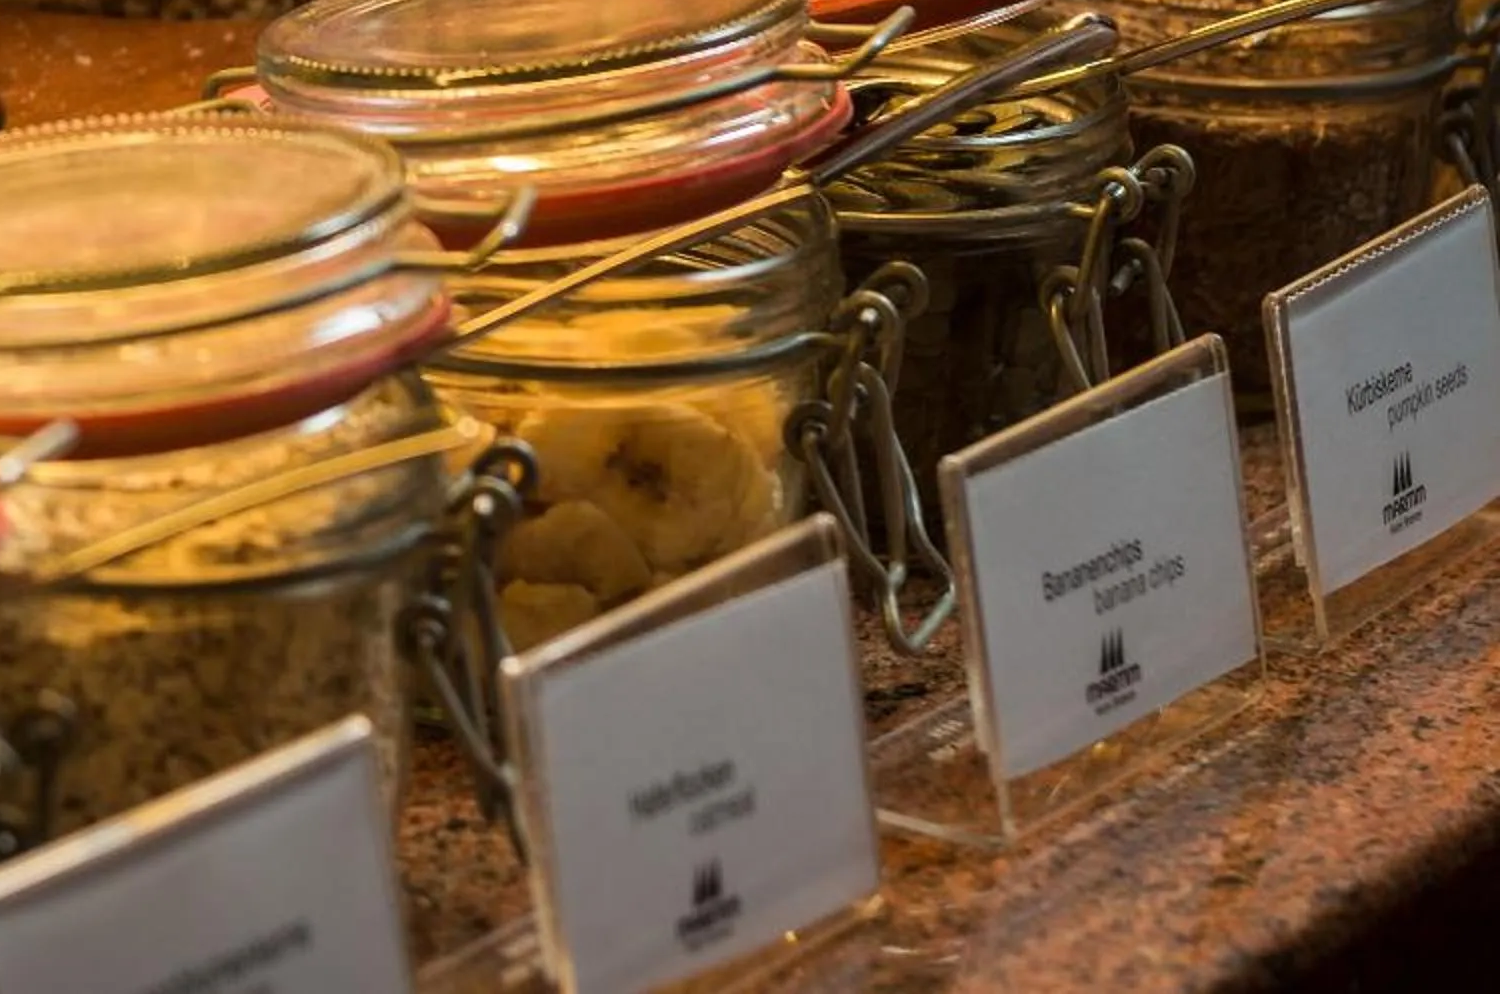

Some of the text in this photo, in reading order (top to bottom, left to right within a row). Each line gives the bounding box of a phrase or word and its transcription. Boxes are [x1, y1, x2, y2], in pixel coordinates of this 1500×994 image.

[1387, 362, 1468, 432] pumpkin seeds
[1094, 555, 1186, 616] banana chips
